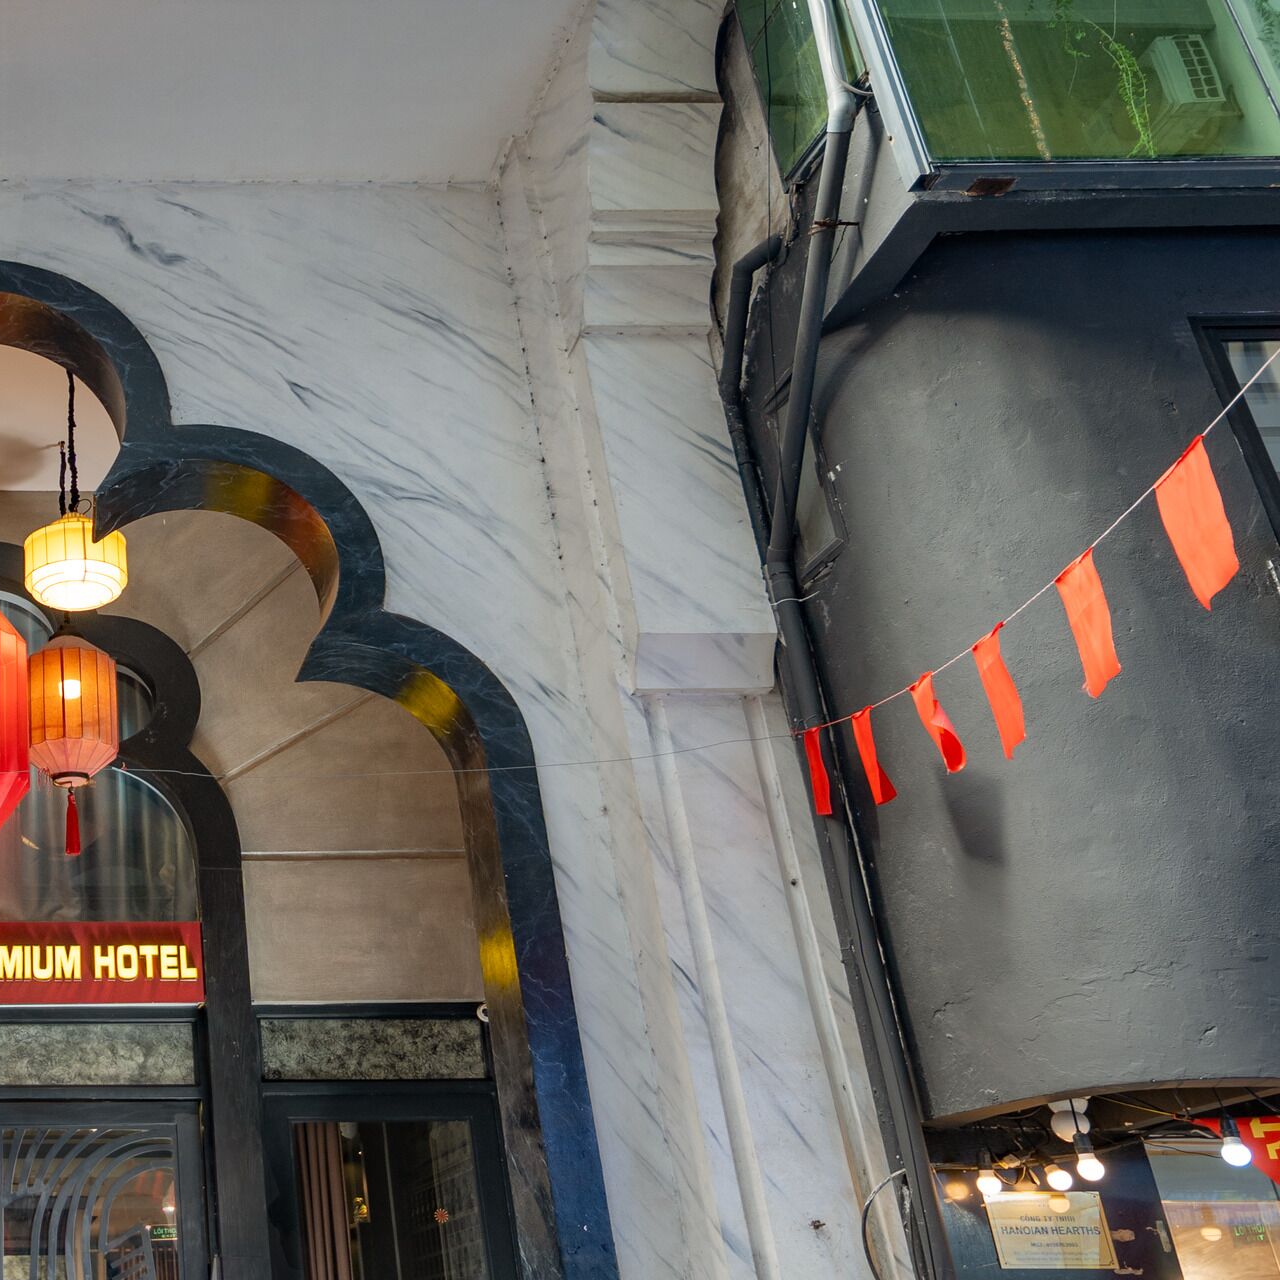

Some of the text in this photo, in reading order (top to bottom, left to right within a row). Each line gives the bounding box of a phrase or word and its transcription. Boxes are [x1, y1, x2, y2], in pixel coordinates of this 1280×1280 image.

[93, 945, 199, 981] HOTEL
[1000, 1225, 1101, 1235] HANOIAN HEARTHS
